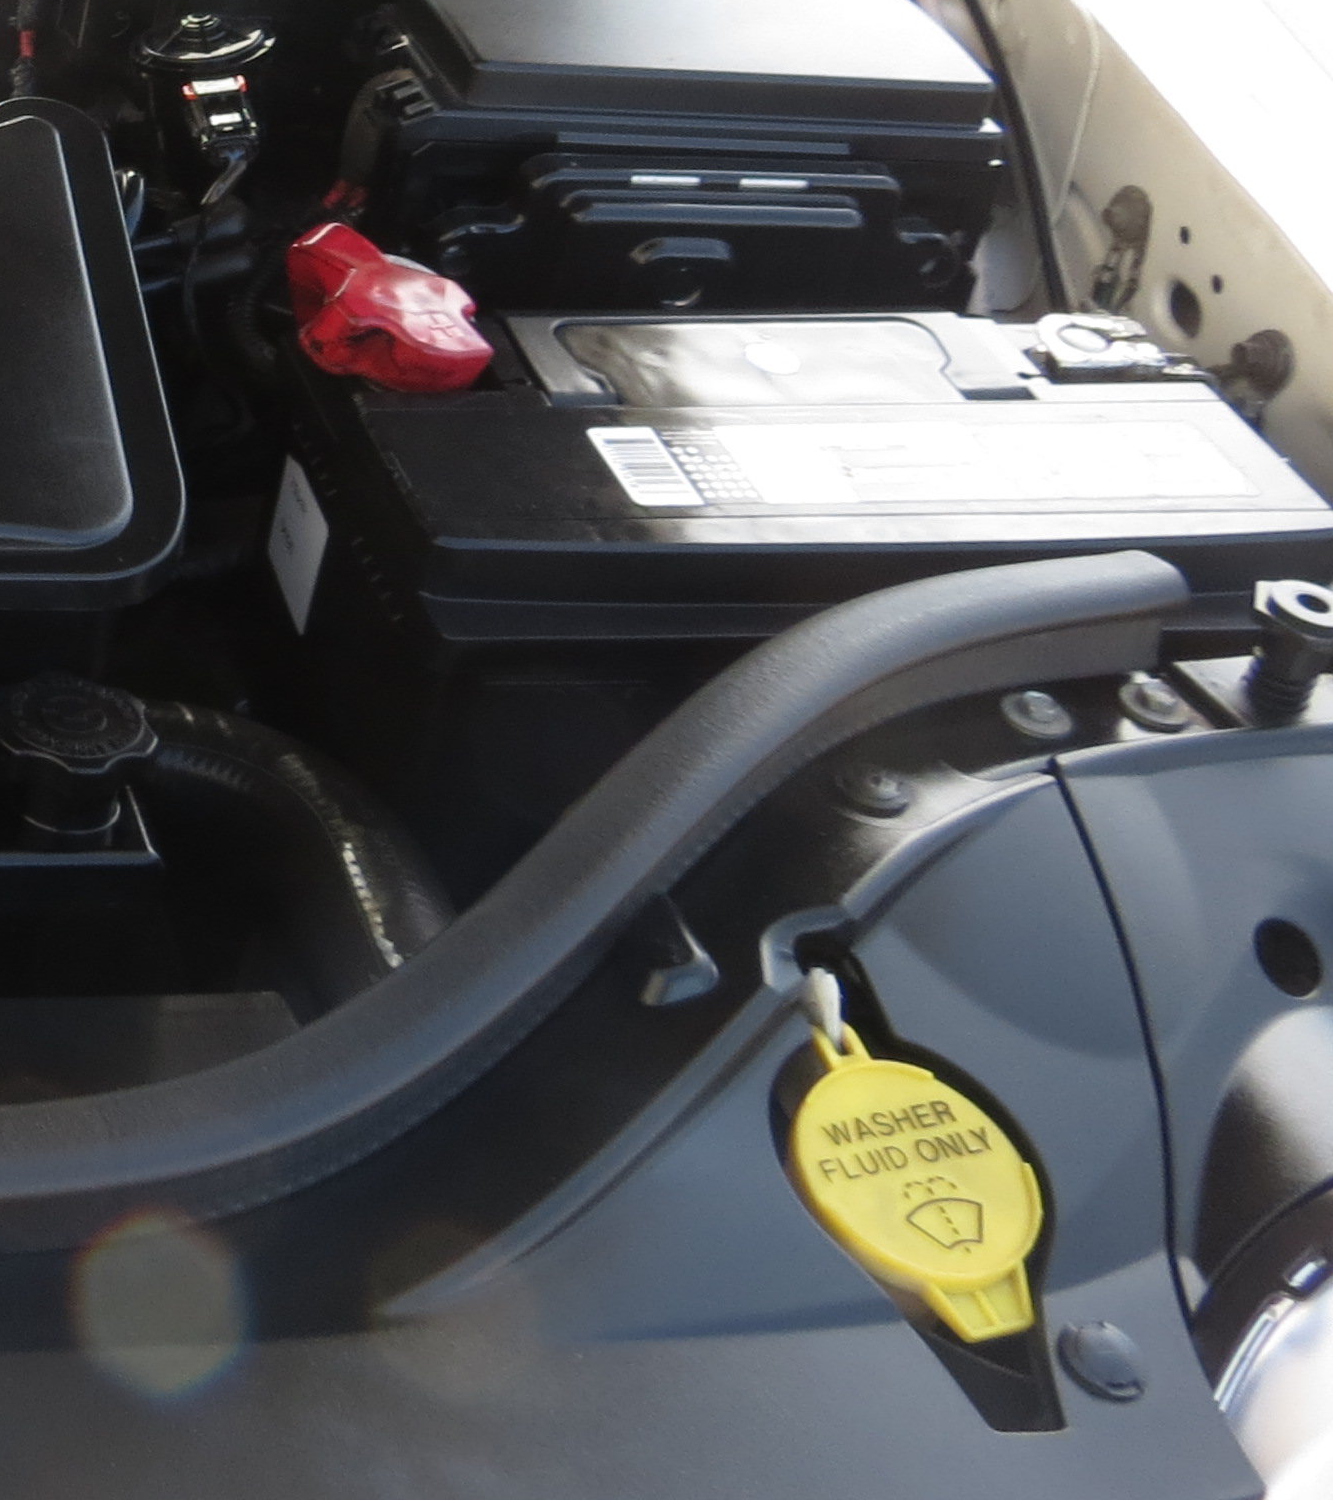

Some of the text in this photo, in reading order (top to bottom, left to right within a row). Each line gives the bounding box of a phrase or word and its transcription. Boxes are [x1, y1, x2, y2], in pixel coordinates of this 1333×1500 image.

[819, 1099, 958, 1148] WASHER
[818, 1125, 993, 1185] FLUID ONLY
